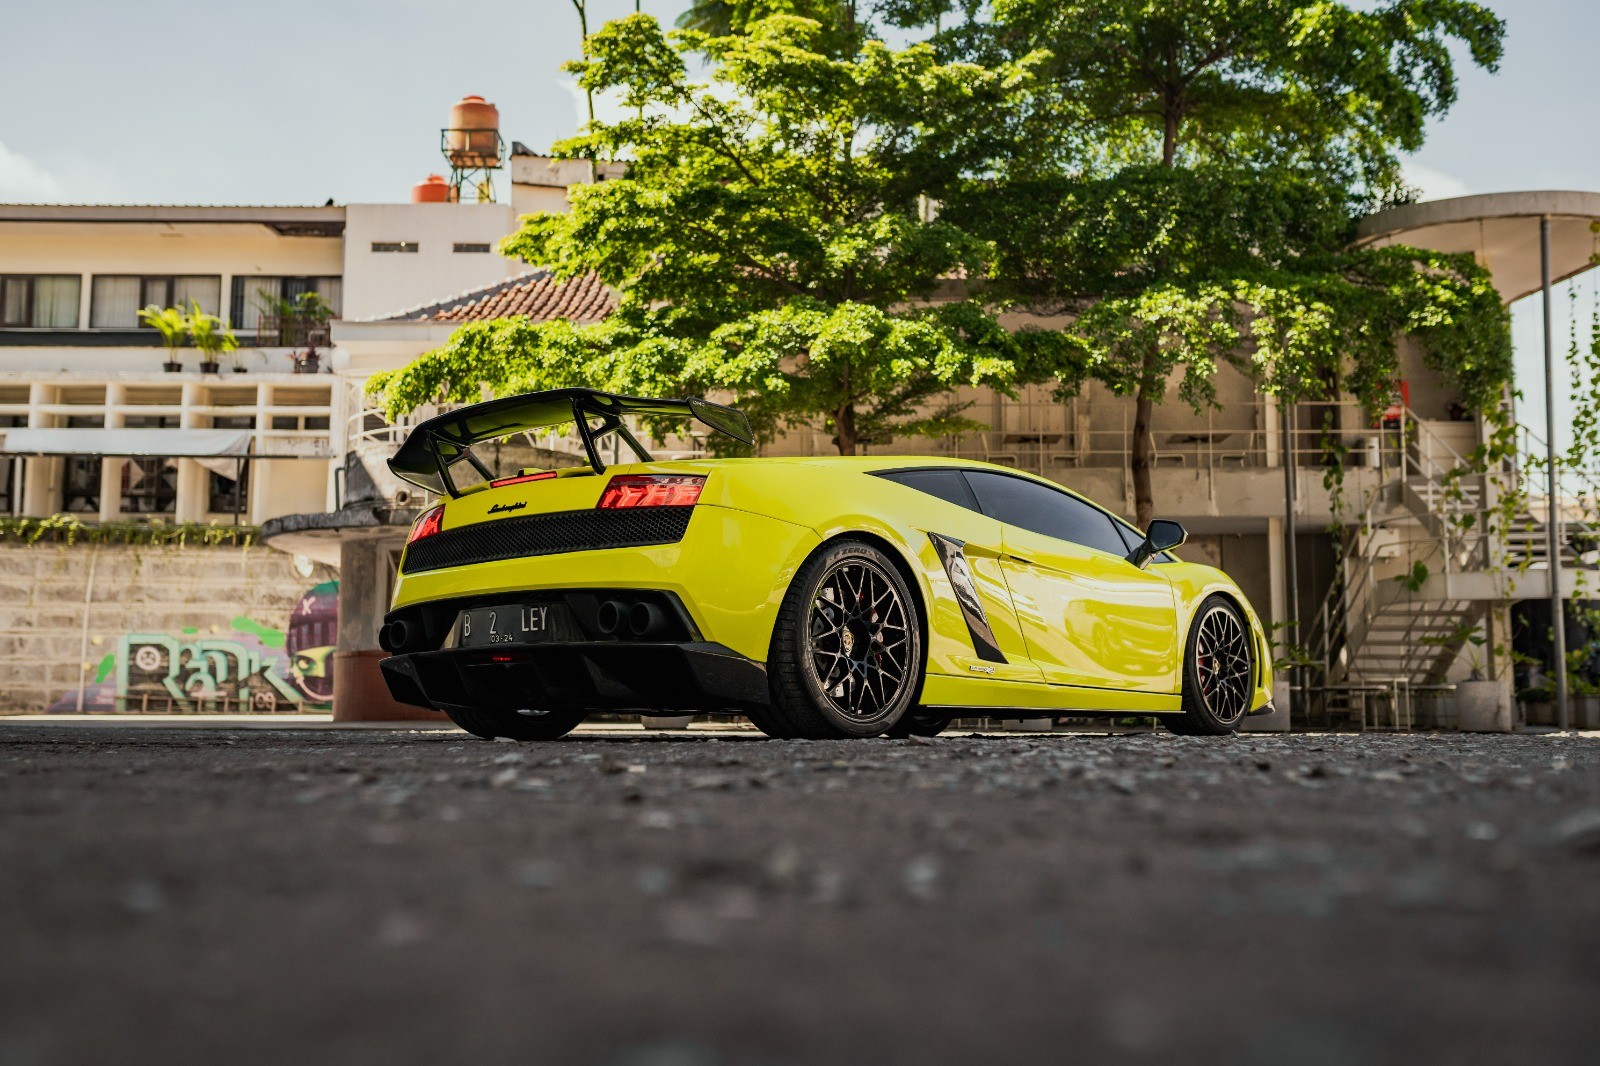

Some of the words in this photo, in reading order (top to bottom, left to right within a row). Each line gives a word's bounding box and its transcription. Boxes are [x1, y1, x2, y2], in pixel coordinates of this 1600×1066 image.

[464, 614, 471, 637] B
[489, 611, 497, 635] 2
[521, 606, 547, 632] LEY
